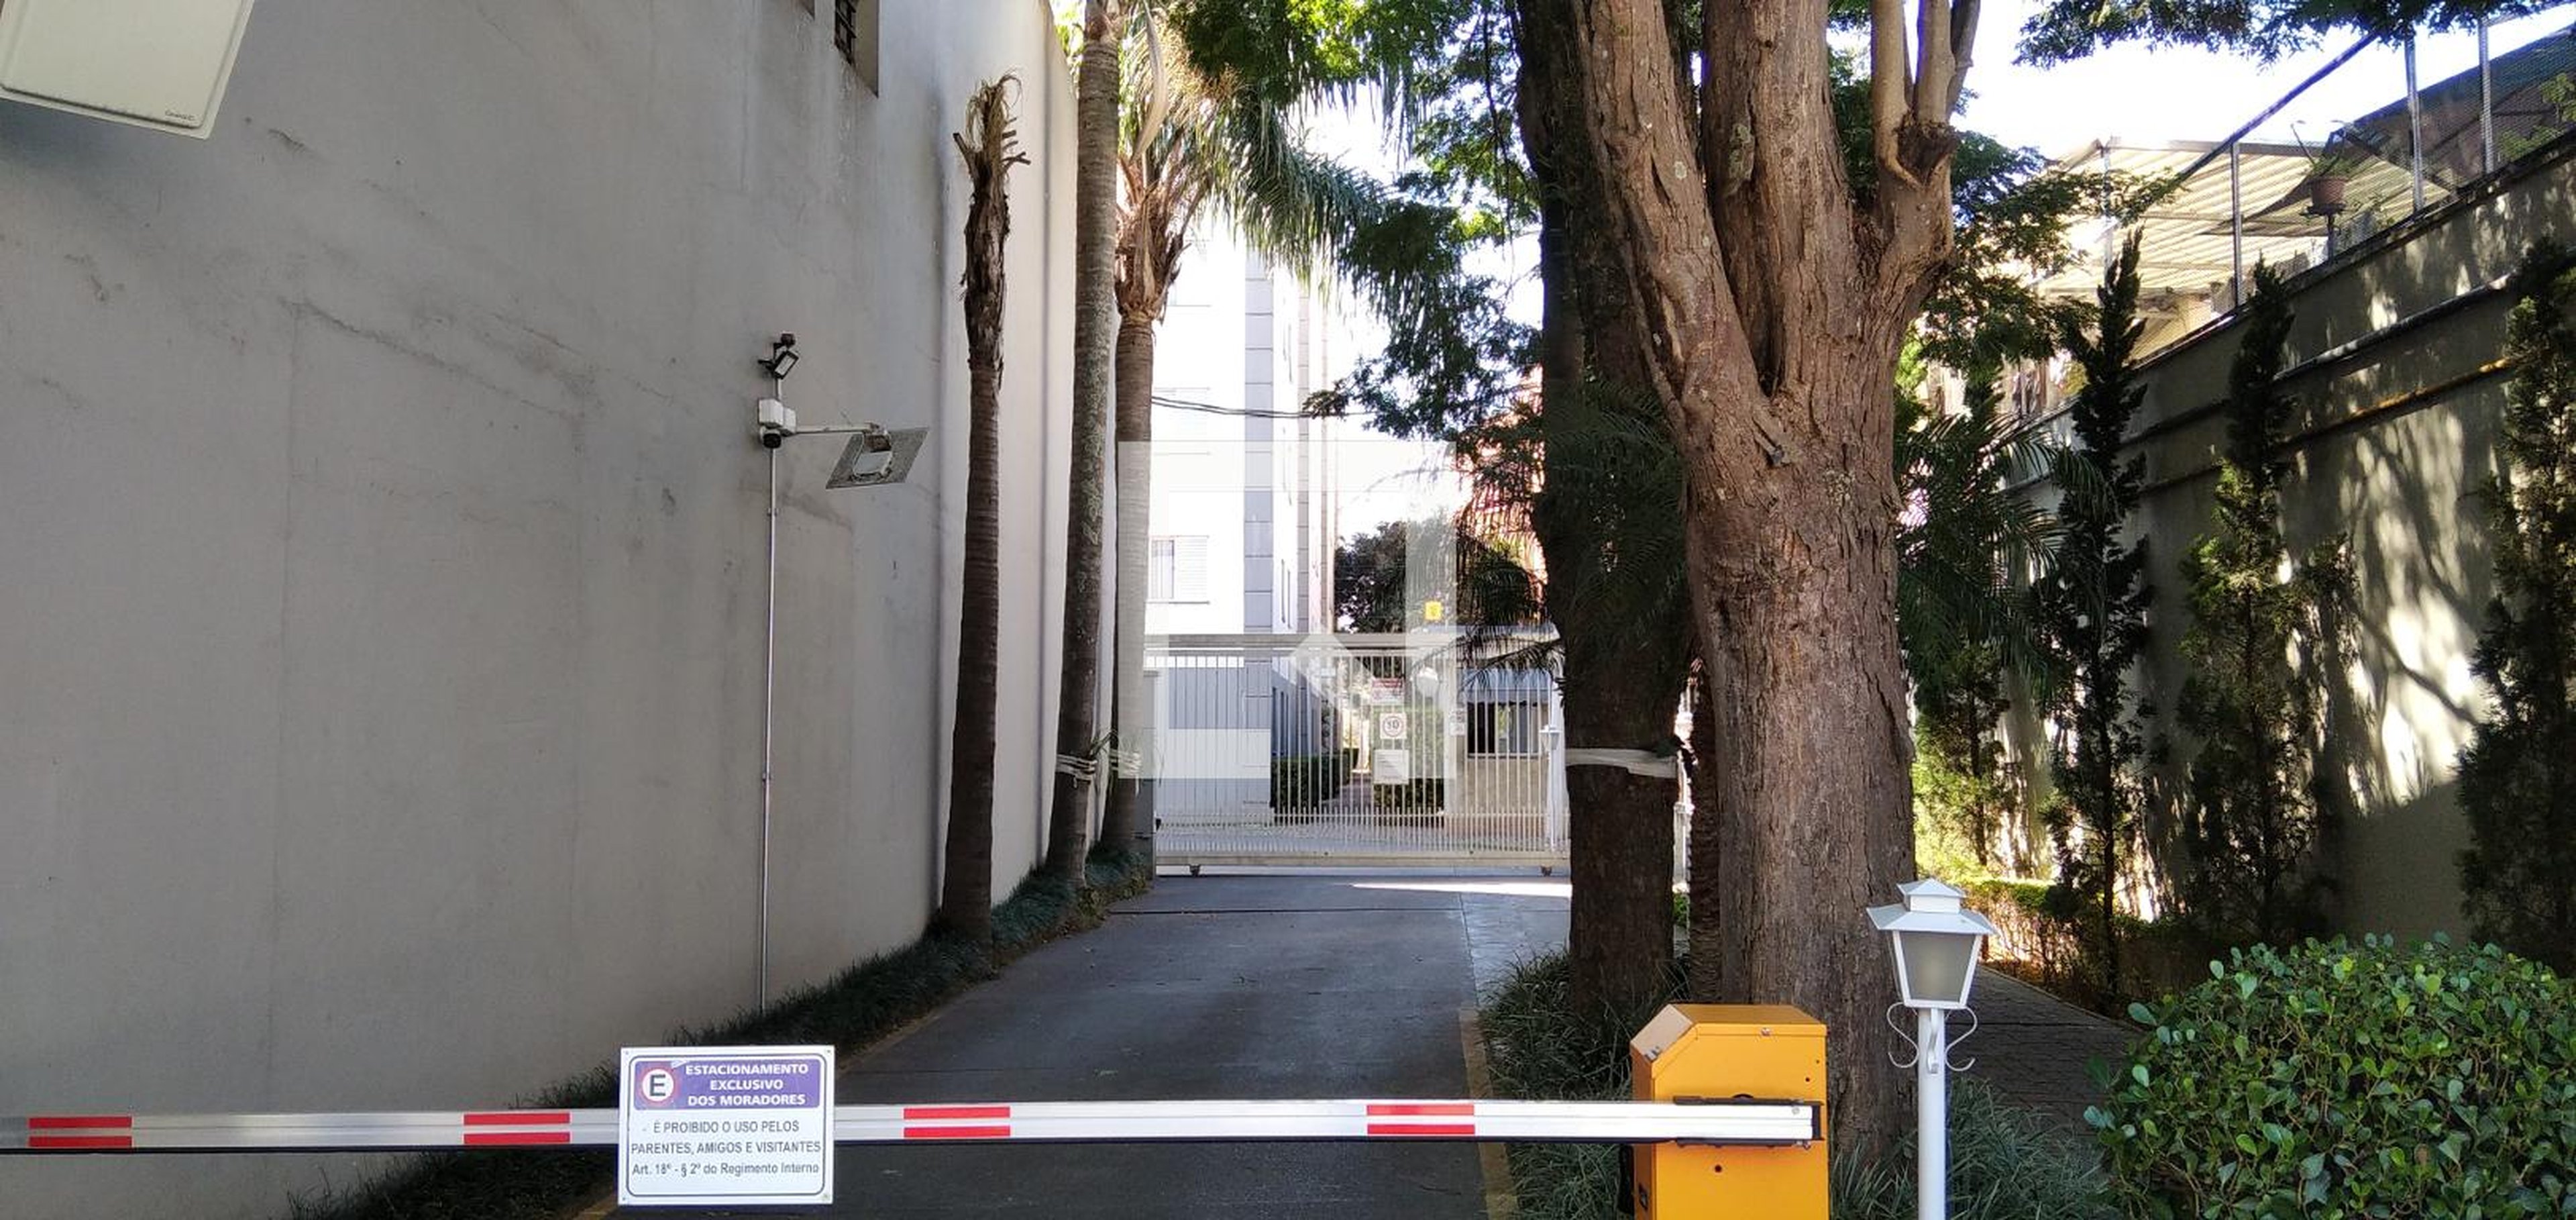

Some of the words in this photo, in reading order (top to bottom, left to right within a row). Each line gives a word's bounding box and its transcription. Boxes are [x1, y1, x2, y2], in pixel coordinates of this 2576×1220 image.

[685, 1064, 809, 1075] ESTACIONAMENTO
[649, 1074, 666, 1097] E
[710, 1079, 784, 1090] EXCLUSIVO
[688, 1095, 716, 1107] DOS
[720, 1094, 806, 1106] MORADORES
[663, 1121, 718, 1133] PROIBIDO
[722, 1121, 731, 1133] O
[734, 1121, 758, 1133] USO
[761, 1119, 800, 1132] PELOS
[631, 1142, 694, 1155] PARENTES,
[696, 1141, 743, 1154] AMIGOS
[745, 1141, 753, 1153] E
[755, 1140, 821, 1153] VISITANTES
[632, 1163, 653, 1175] Art.
[681, 1162, 687, 1178] §
[703, 1163, 717, 1174] do
[720, 1162, 778, 1177] Regimento
[780, 1162, 819, 1174] Interno
